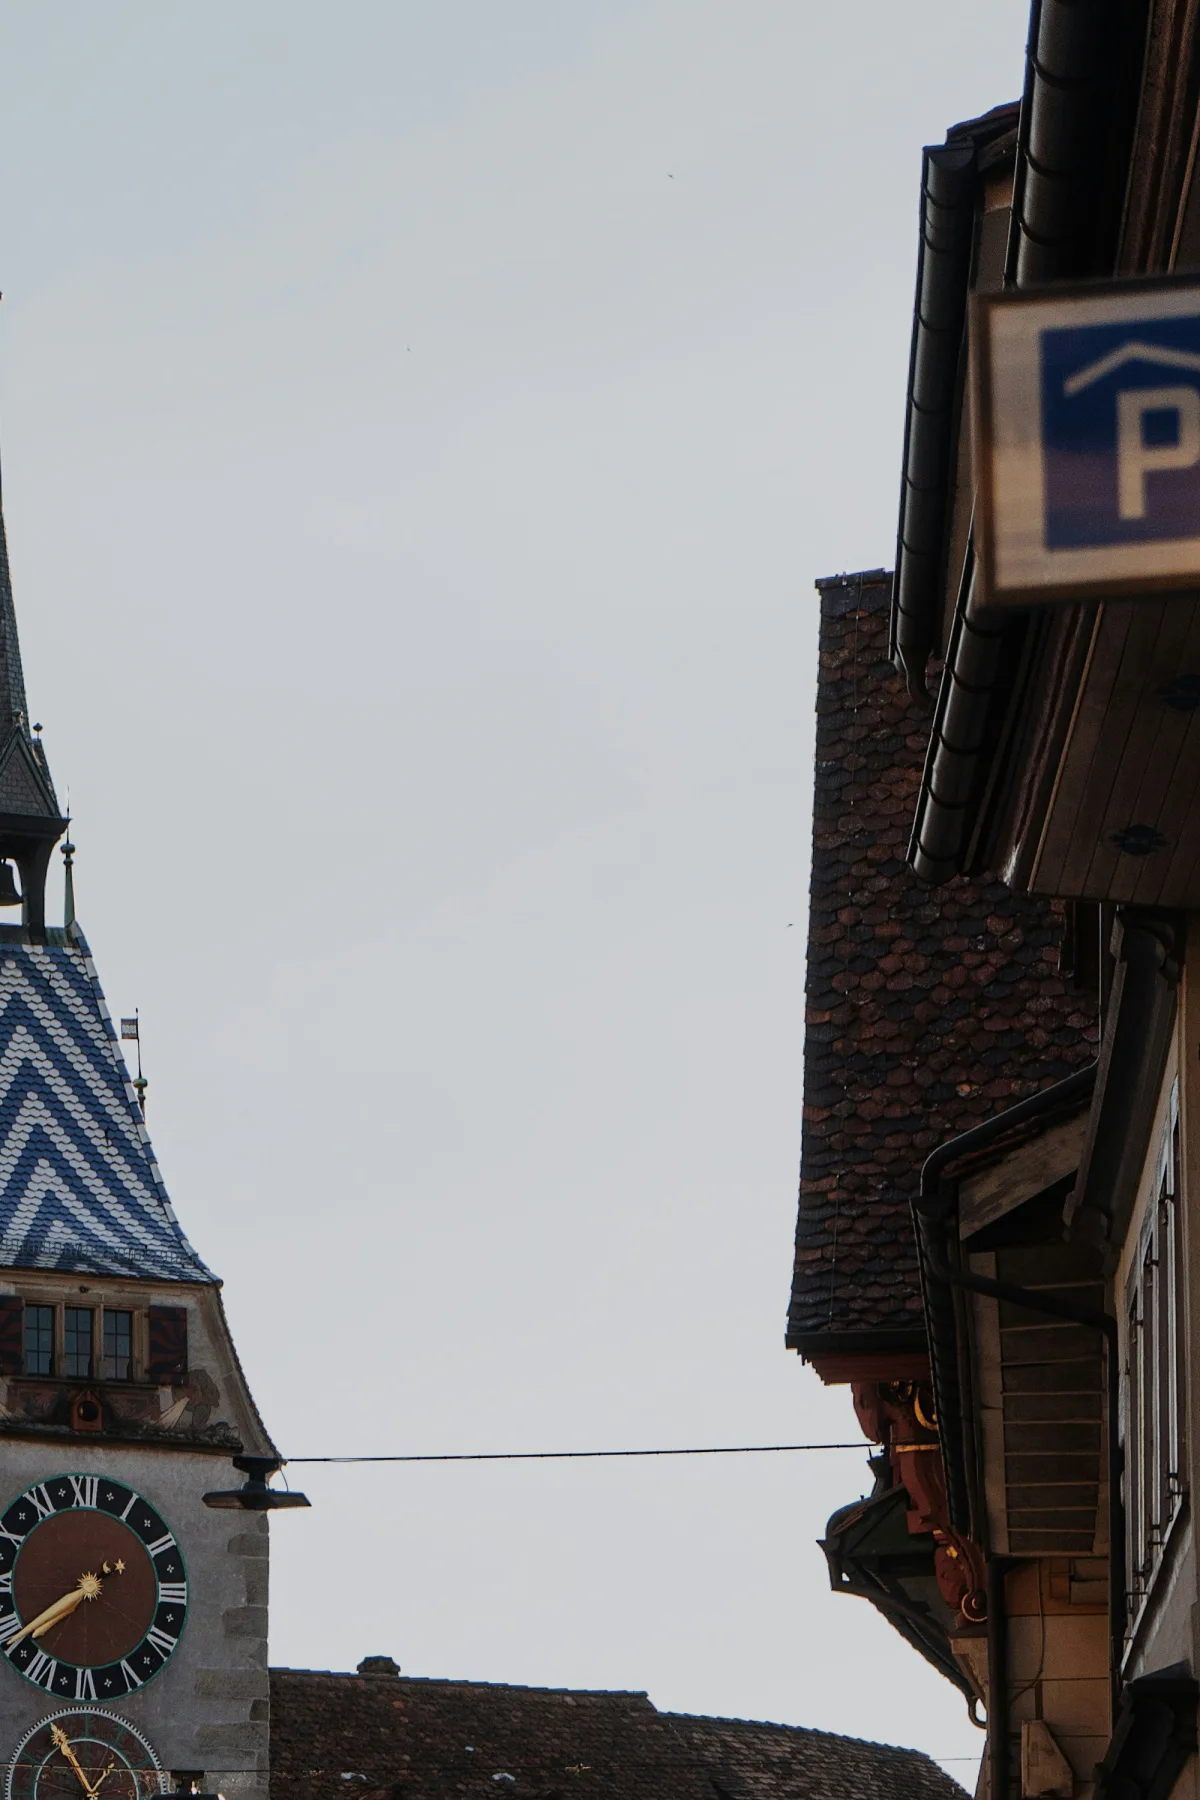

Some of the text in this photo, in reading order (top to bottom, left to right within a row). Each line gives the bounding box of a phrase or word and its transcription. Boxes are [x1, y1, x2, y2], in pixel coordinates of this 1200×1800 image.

[1116, 385, 1200, 520] P
[23, 1483, 57, 1522] XI
[68, 1476, 100, 1508] XII
[119, 1492, 140, 1522] I
[146, 1532, 177, 1557] II
[158, 1582, 187, 1606] III
[146, 1625, 178, 1662] IV
[23, 1648, 58, 1691] VII
[75, 1669, 99, 1700] VI
[120, 1659, 144, 1692] V
